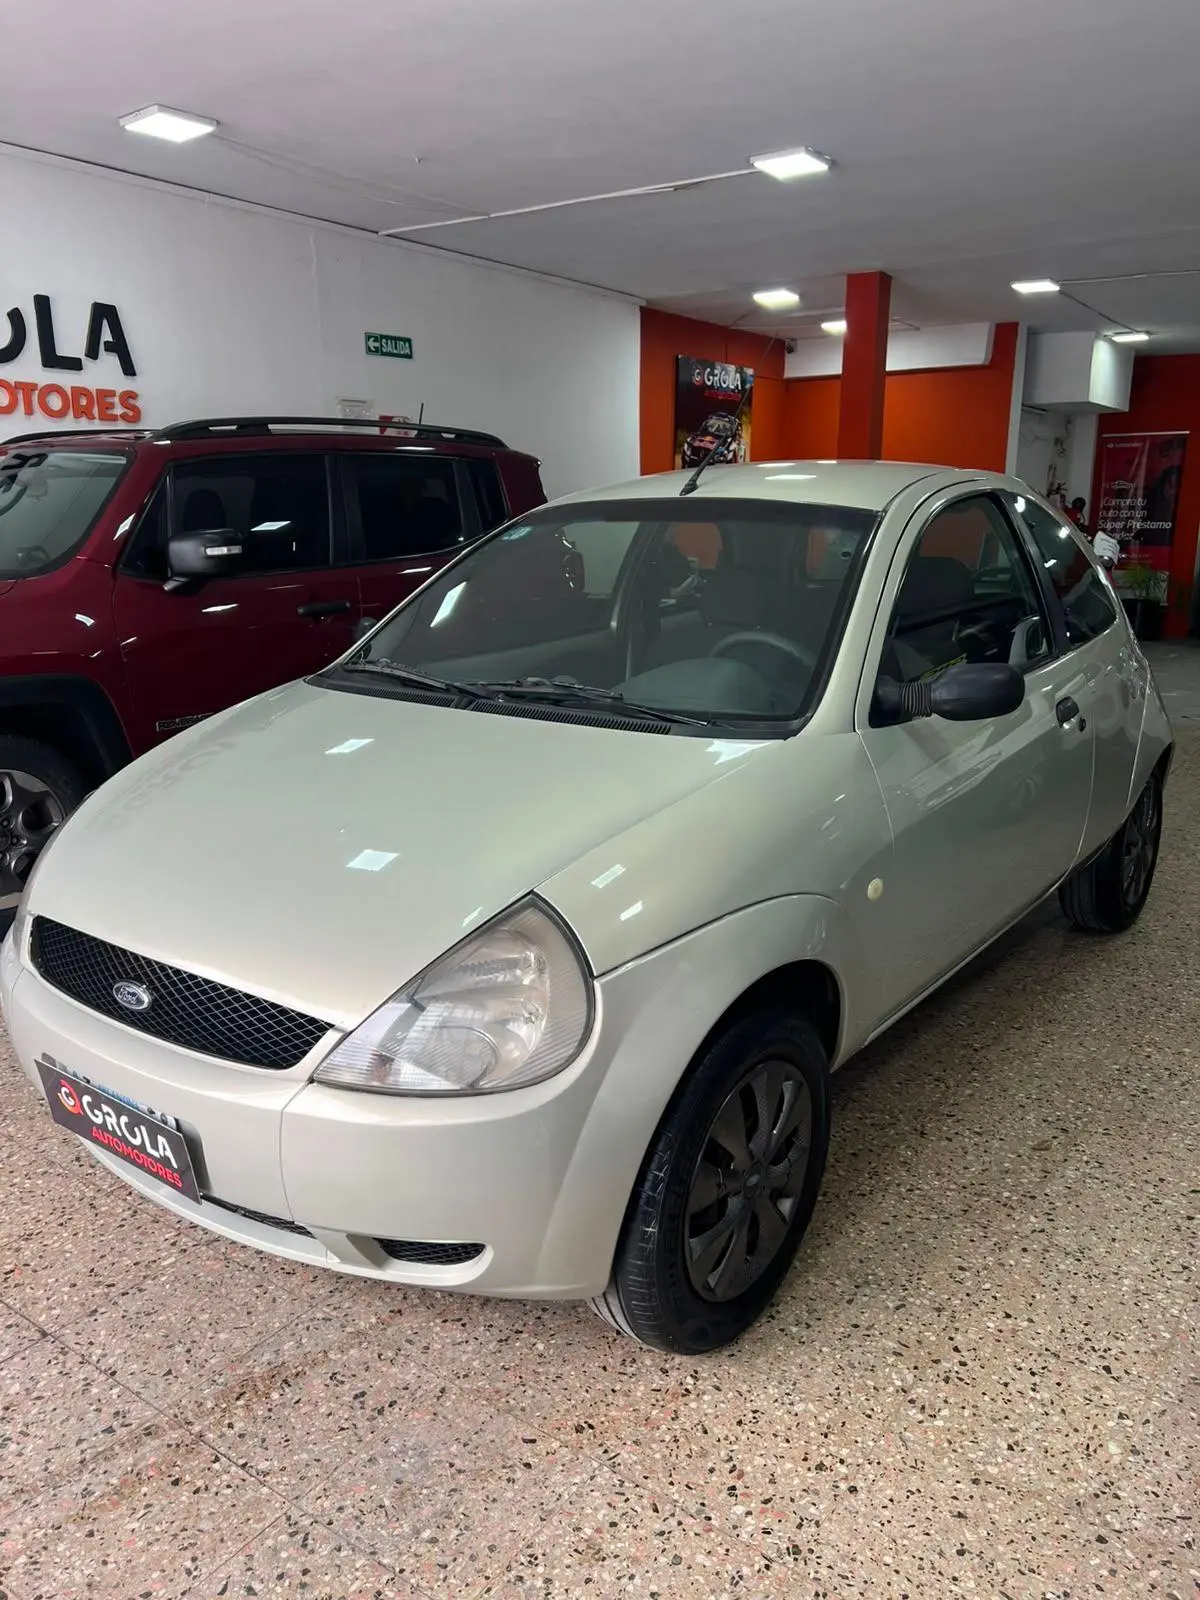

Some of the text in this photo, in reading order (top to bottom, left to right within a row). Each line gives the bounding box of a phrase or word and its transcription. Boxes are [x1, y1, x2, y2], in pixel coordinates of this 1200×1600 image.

[381, 338, 411, 355] SALIDA
[704, 367, 742, 390] GROLA
[1137, 497, 1148, 506] tu
[1099, 509, 1118, 517] auto
[82, 1094, 178, 1169] GROLA
[91, 1125, 182, 1188] AUTOMOTORES
